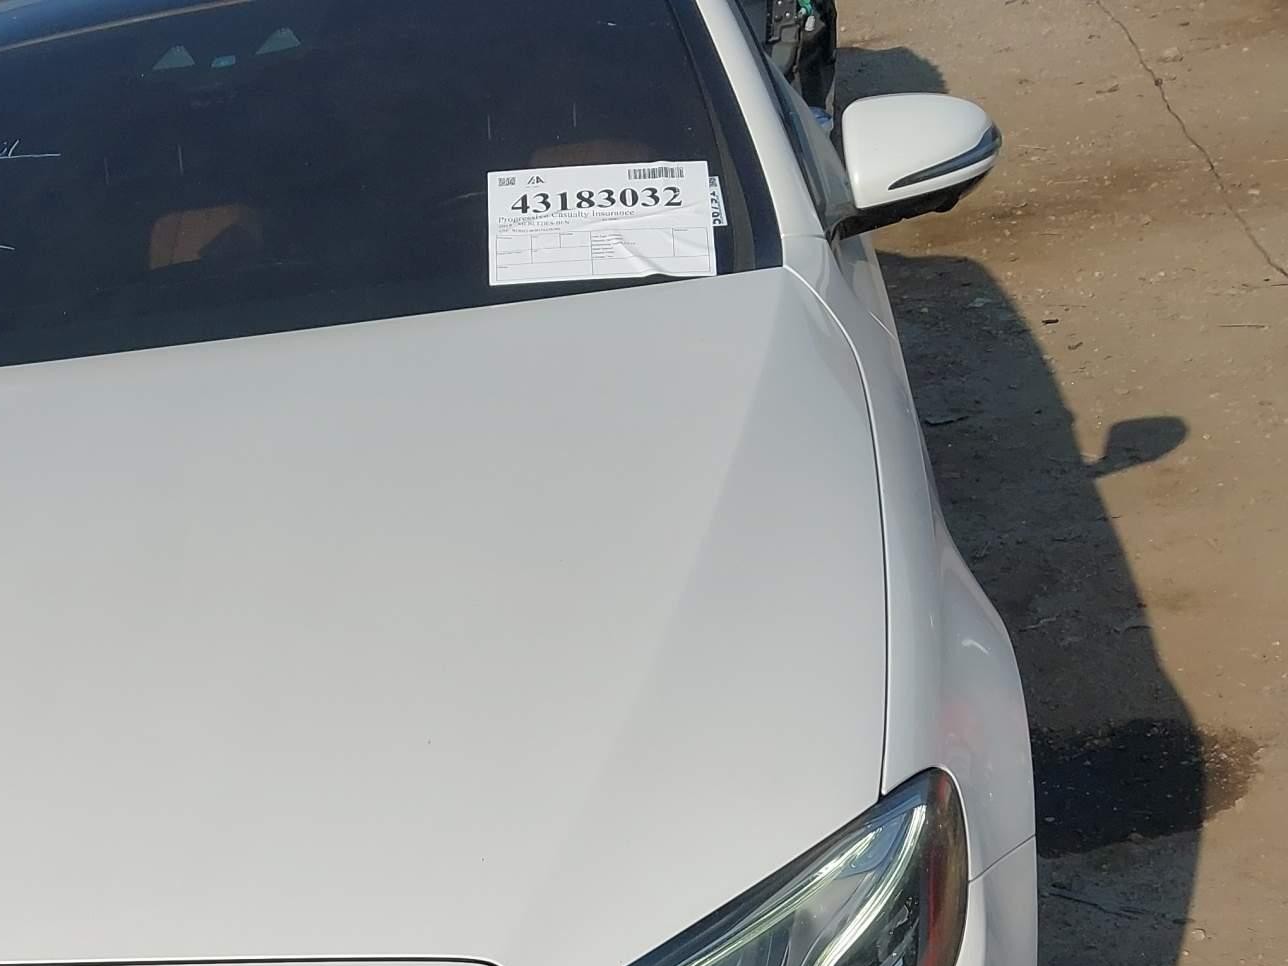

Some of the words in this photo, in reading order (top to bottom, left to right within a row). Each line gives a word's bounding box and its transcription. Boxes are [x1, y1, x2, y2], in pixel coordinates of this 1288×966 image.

[511, 186, 683, 214] 43183032
[497, 213, 550, 224] Progressive
[551, 209, 589, 219] Casualty
[592, 209, 635, 217] Insurance
